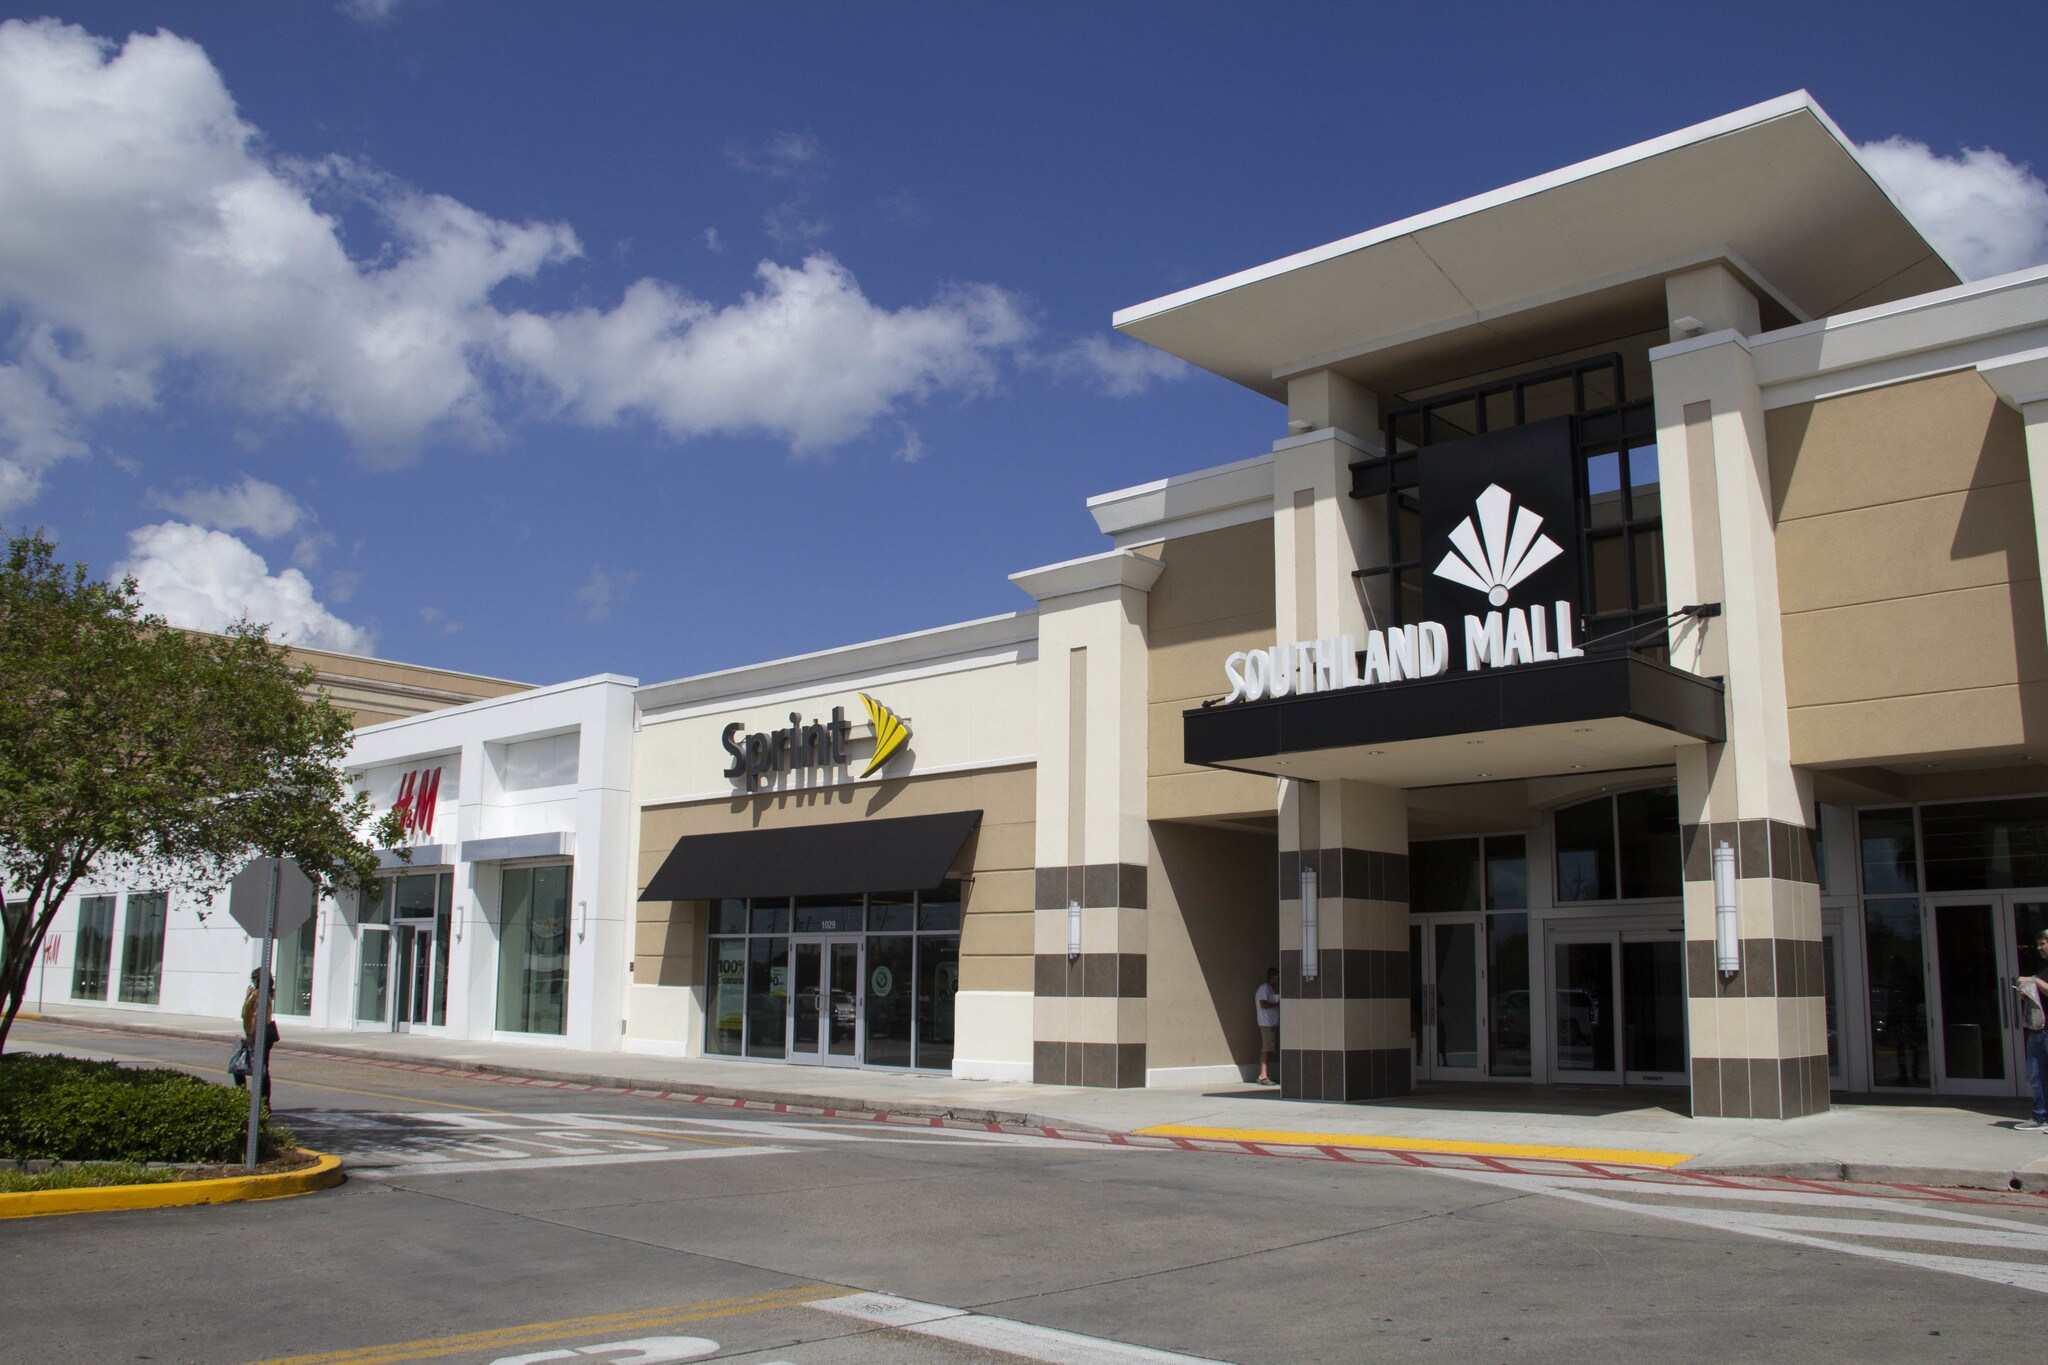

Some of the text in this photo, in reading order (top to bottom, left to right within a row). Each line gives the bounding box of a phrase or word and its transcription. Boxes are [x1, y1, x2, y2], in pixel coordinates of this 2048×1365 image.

[1225, 600, 1584, 703] SOUTHLAND MALL
[721, 705, 851, 792] Sprint
[391, 766, 442, 837] H&M
[821, 920, 836, 930] 1029
